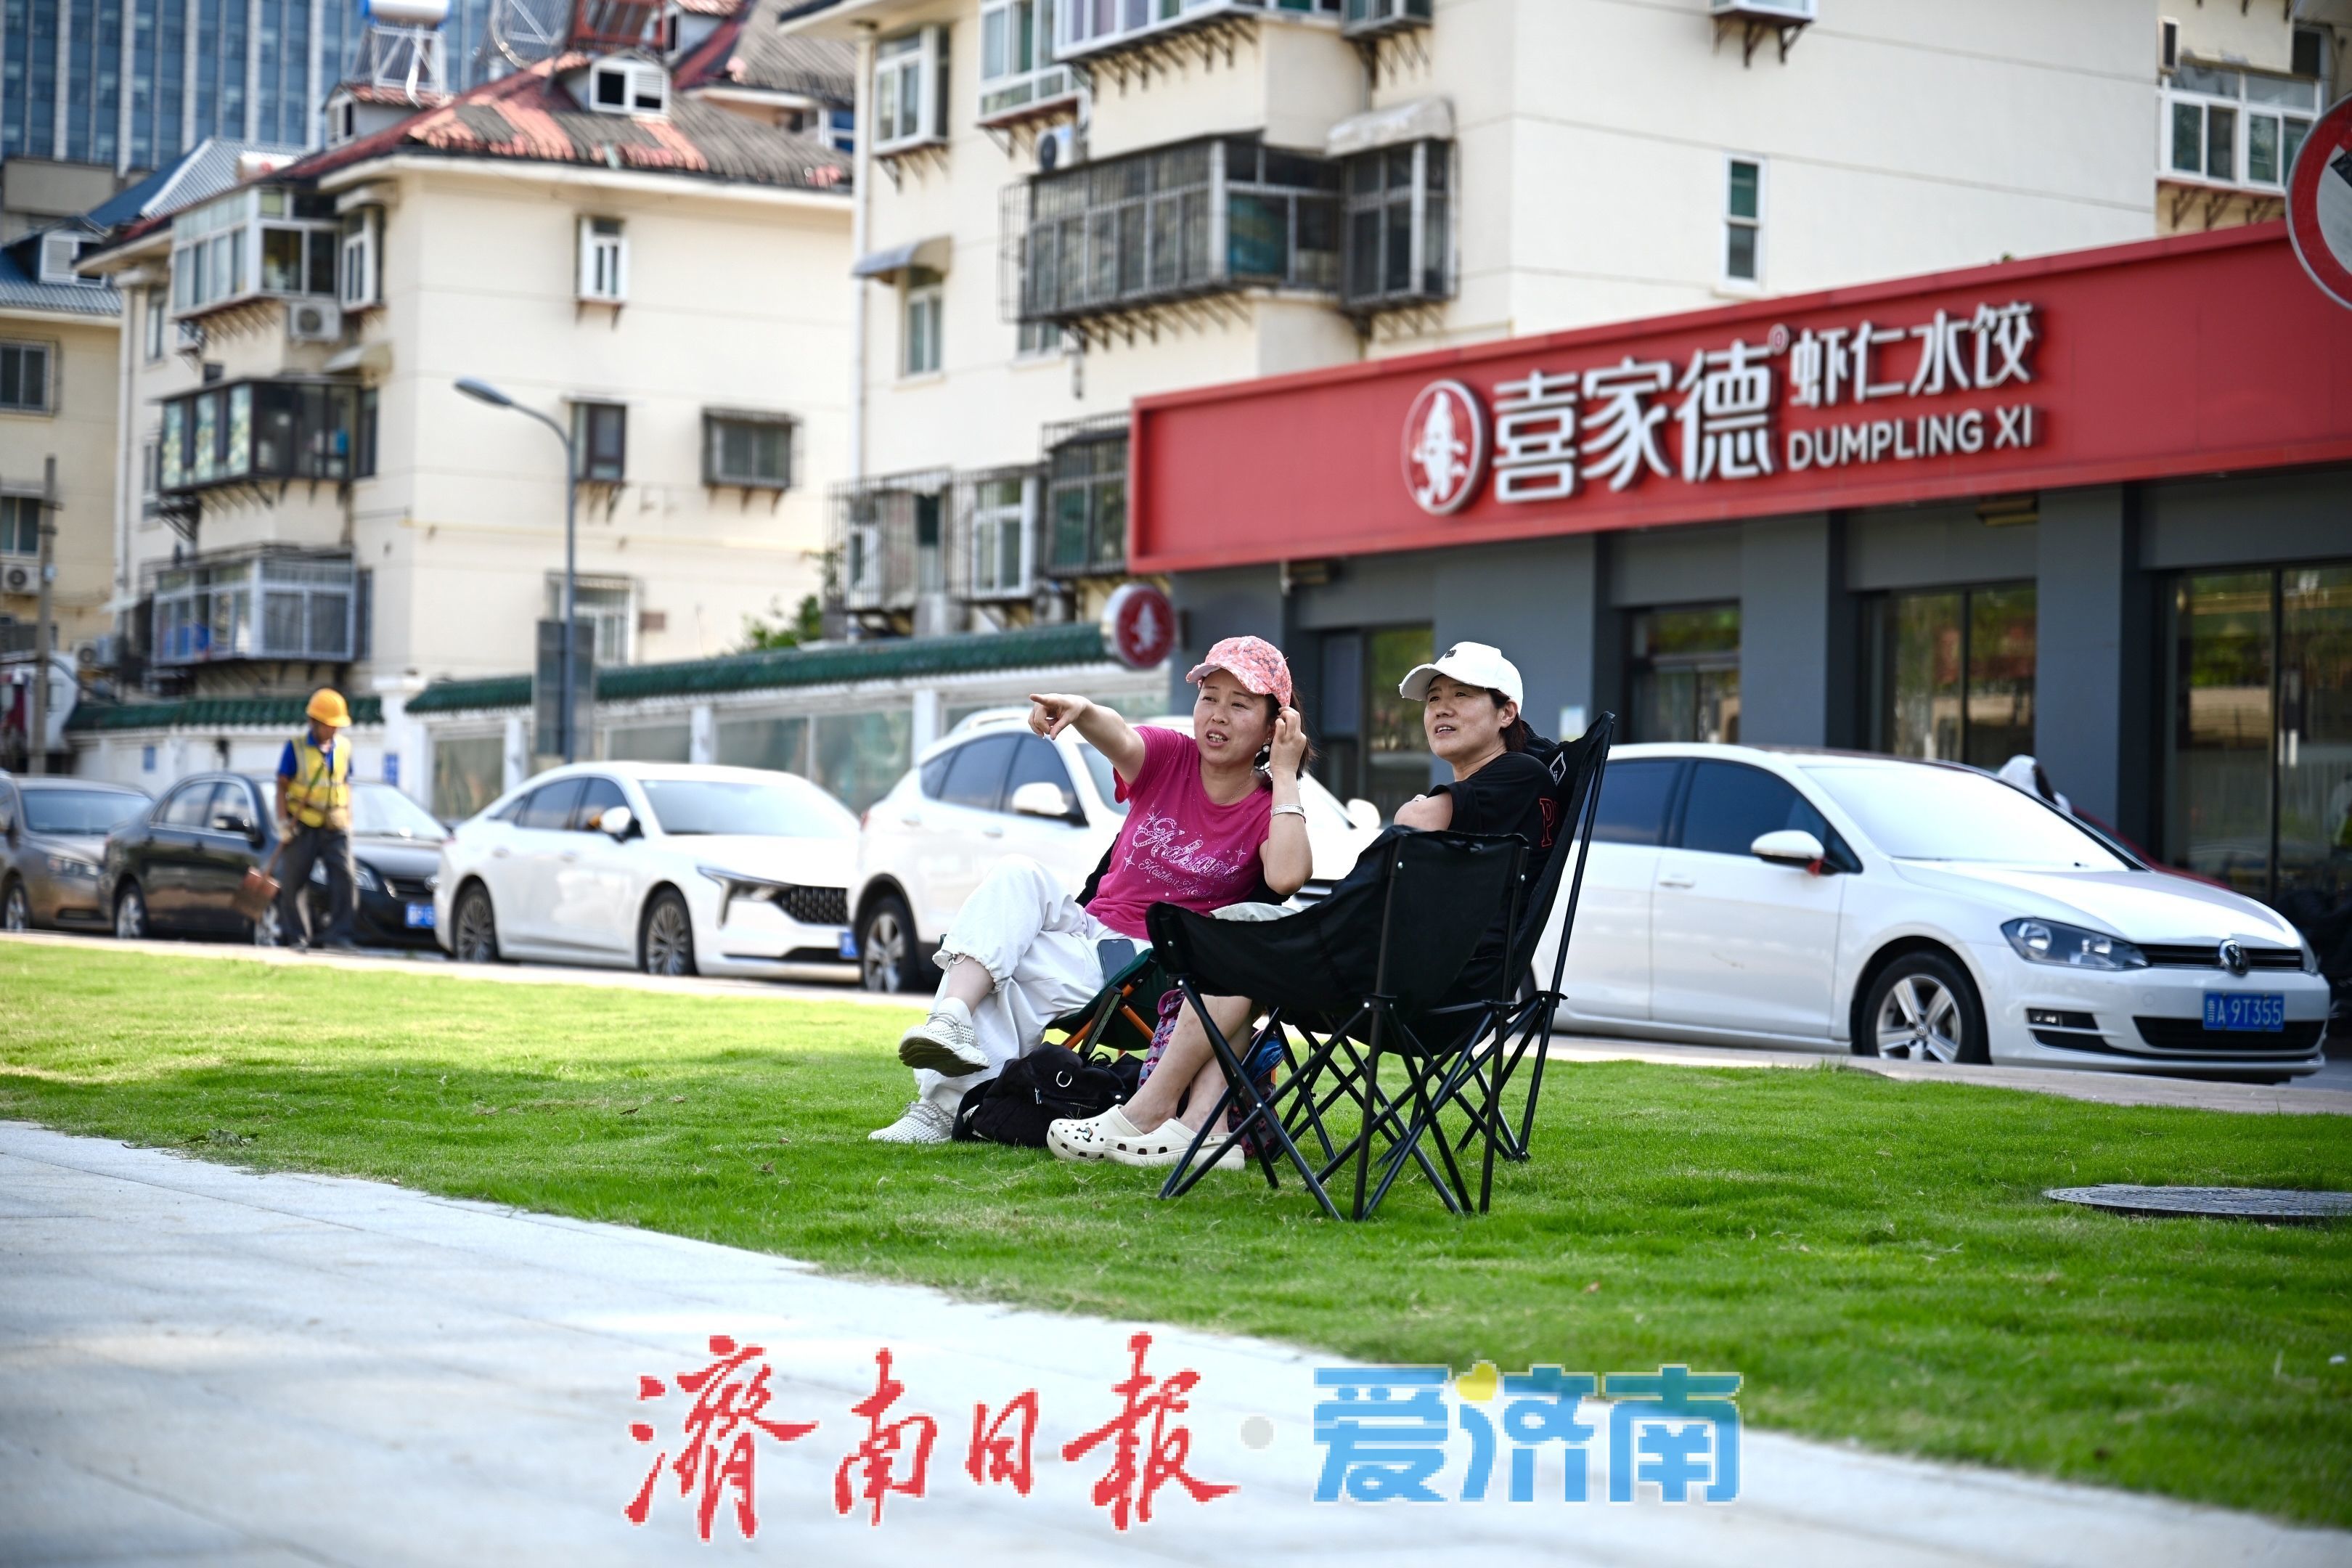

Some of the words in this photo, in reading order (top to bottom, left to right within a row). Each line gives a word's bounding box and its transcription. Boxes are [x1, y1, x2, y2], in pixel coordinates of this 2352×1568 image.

[1789, 301, 2033, 409] 虾仁水饺
[1491, 338, 1773, 504] 喜家德
[1787, 409, 1985, 472] DUMPLING
[1993, 404, 2033, 451] XI
